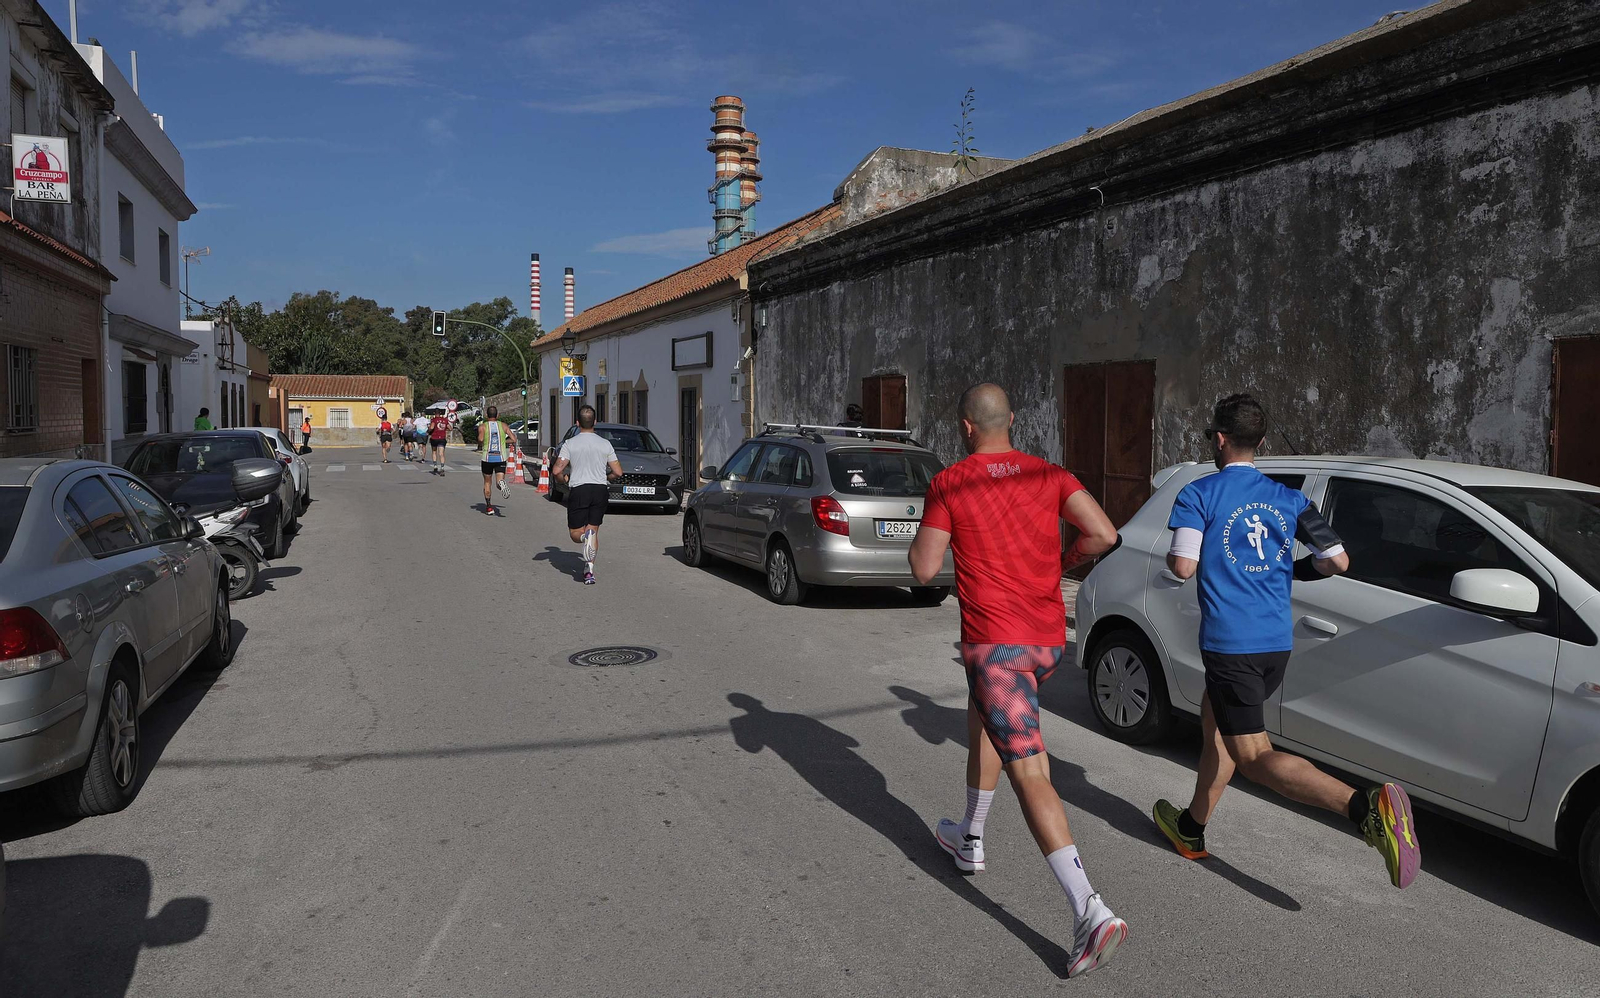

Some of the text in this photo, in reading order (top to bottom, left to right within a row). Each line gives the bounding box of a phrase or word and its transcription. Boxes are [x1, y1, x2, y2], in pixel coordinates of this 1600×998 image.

[20, 170, 63, 180] Cruzcampo
[28, 181, 56, 190] BAR
[18, 190, 64, 199] LA PEÑA
[886, 522, 912, 533] 2622
[1223, 502, 1290, 564] LOURDIANS ATHLETIC CLUB
[1370, 808, 1385, 838] HOKA
